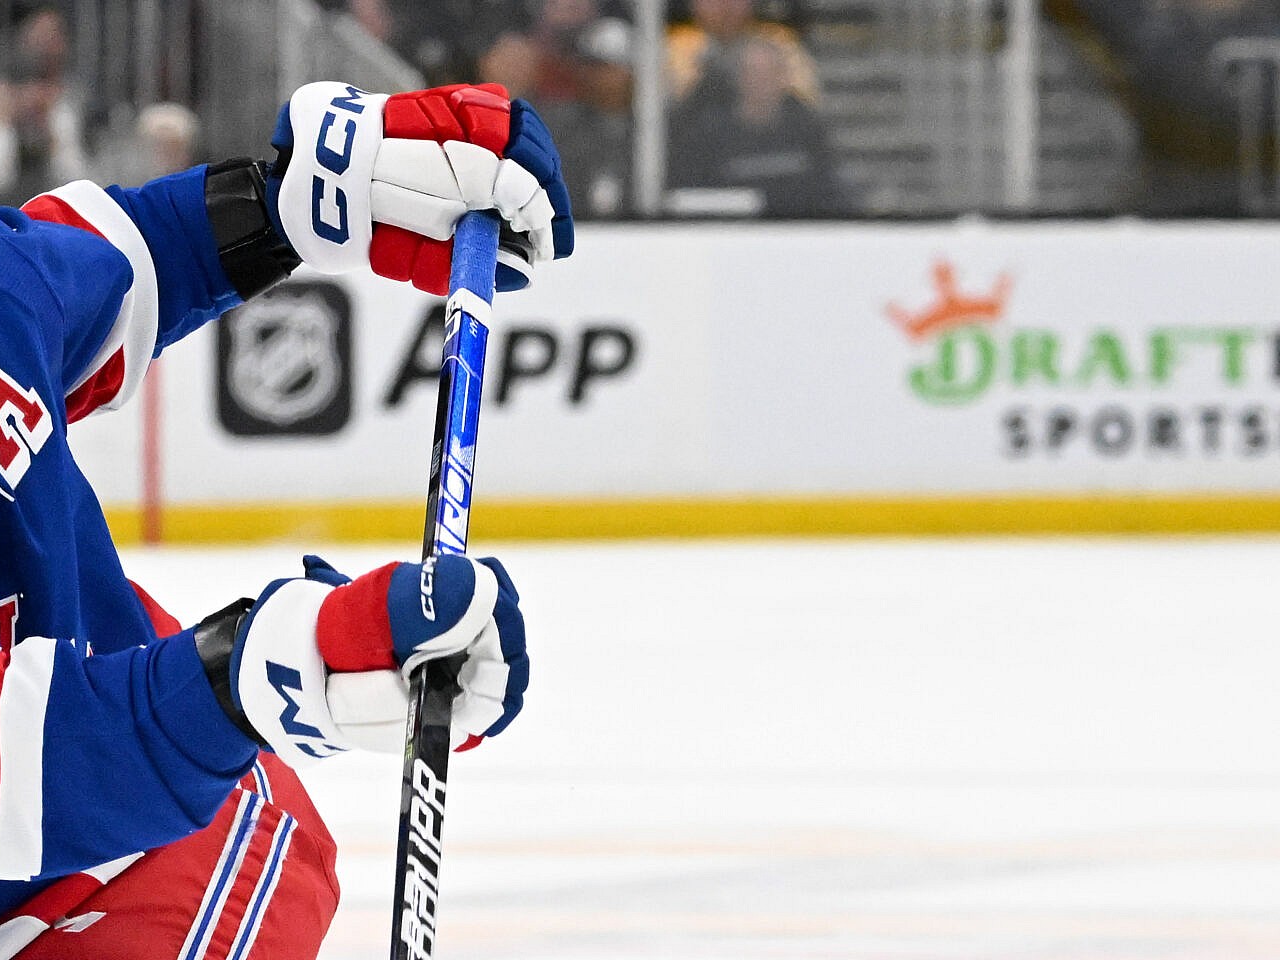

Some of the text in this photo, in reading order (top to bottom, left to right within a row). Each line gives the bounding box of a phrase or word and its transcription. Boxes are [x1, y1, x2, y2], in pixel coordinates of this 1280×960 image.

[311, 86, 370, 246] CCM
[378, 302, 638, 408] APP
[906, 327, 1280, 406] DRAFT
[420, 556, 437, 622] CCM
